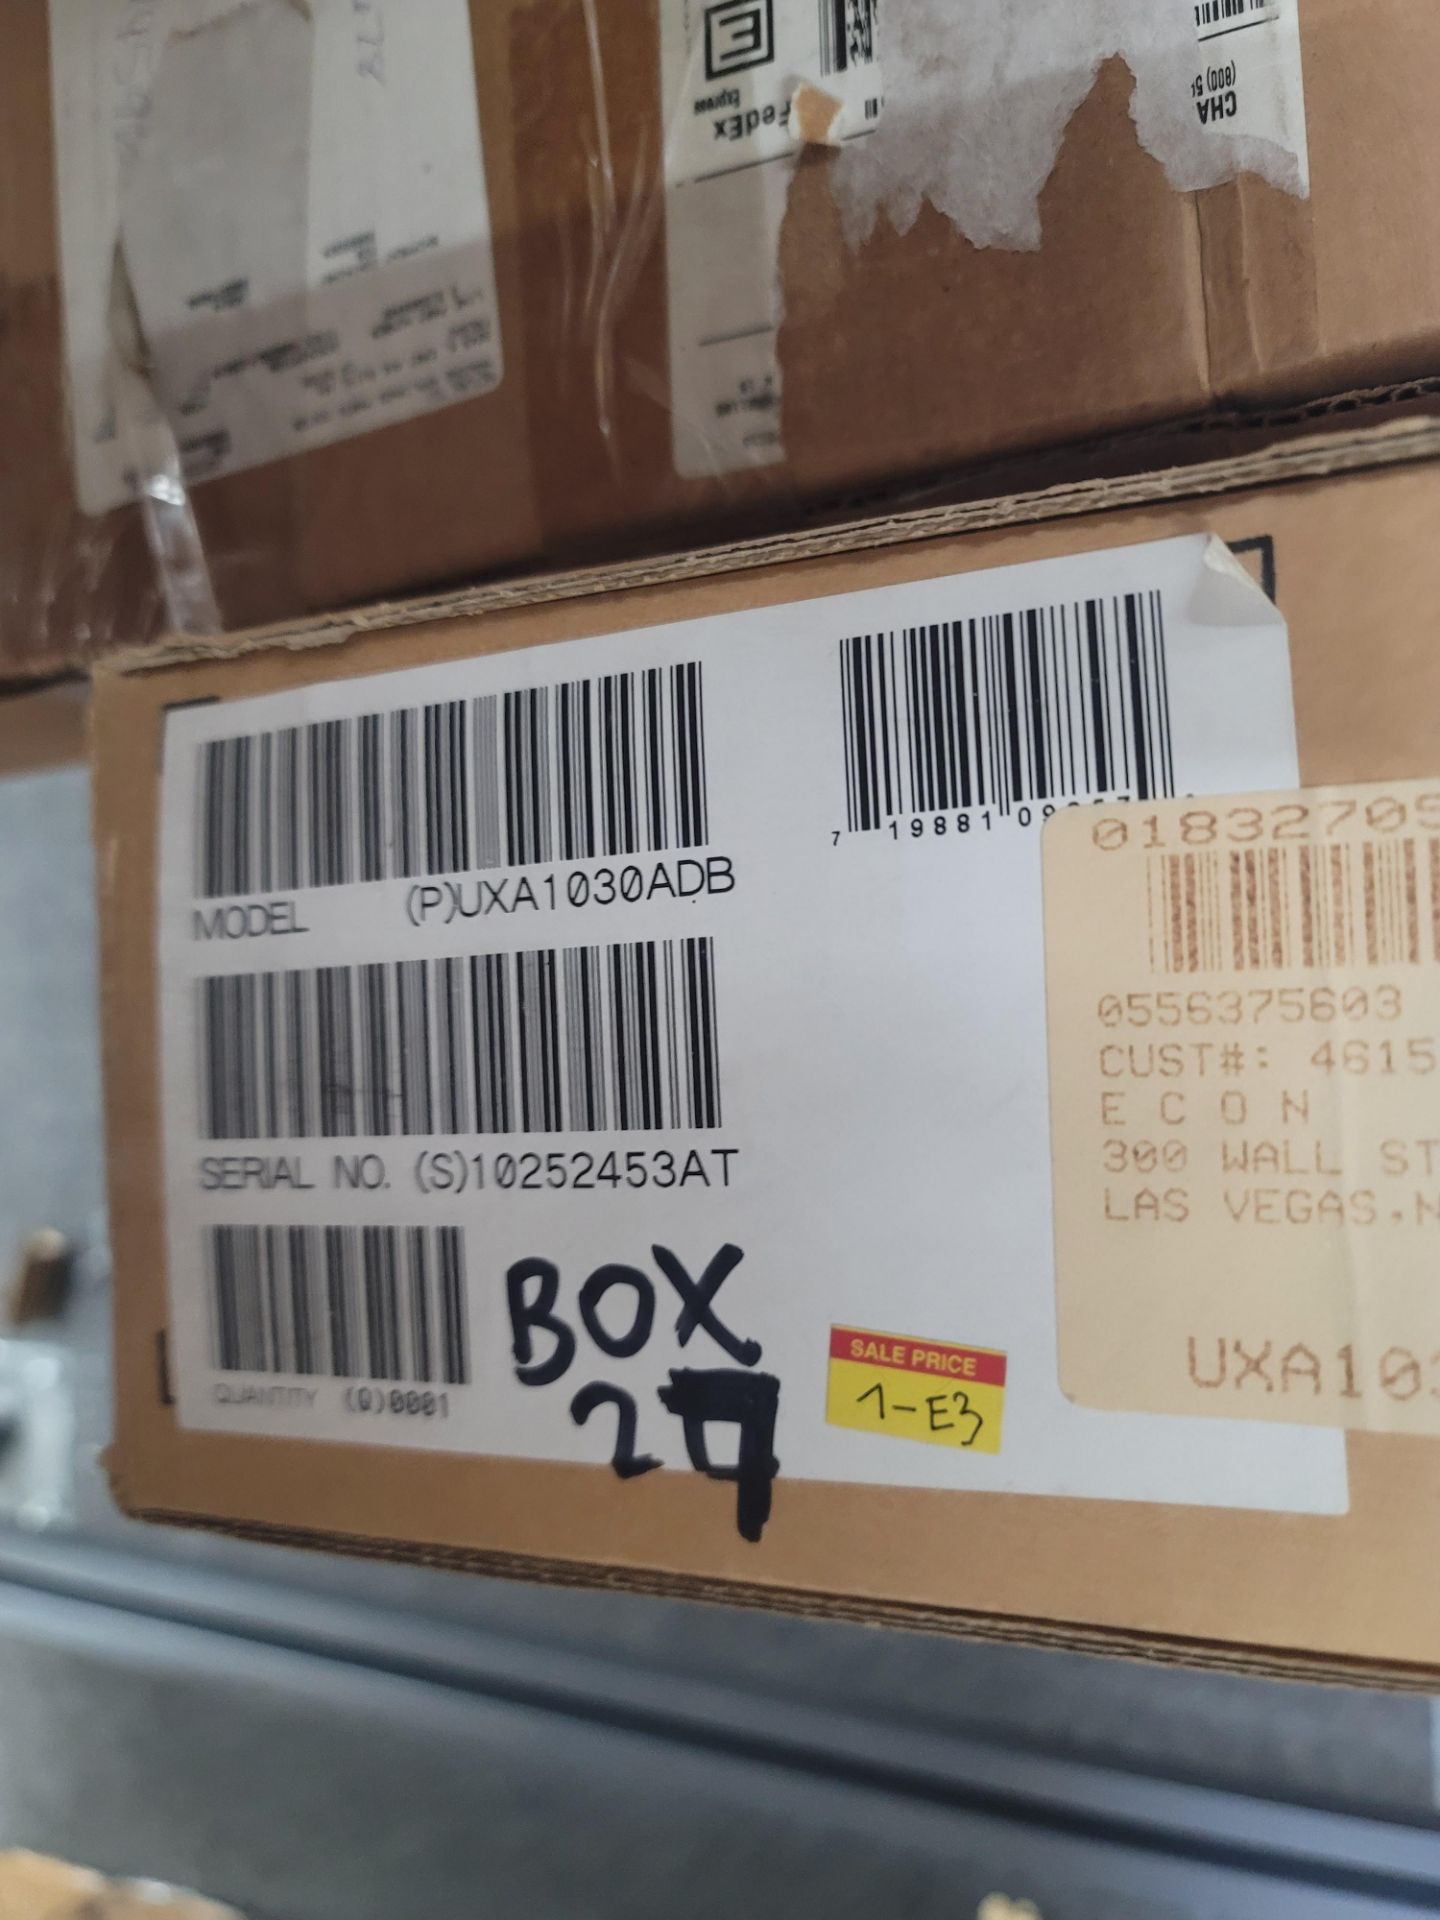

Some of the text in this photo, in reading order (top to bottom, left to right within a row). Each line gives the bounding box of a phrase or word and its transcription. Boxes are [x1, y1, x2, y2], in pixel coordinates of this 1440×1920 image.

[1206, 59, 1236, 93] (800)
[1196, 90, 1237, 125] CHA
[831, 831, 842, 846] 7
[888, 810, 993, 840] 19881
[195, 900, 310, 942] MODEL
[1098, 984, 1402, 1028] 0556375603
[1099, 1042, 1269, 1077] CUST#:
[200, 1148, 739, 1195] SERIAL NO. (S)10252453AT
[1102, 1138, 1188, 1174] 300
[1222, 1138, 1343, 1175] WALL
[1104, 1187, 1191, 1223] LAS
[507, 1243, 762, 1386] BOX
[850, 1339, 977, 1377] SALE PRICE
